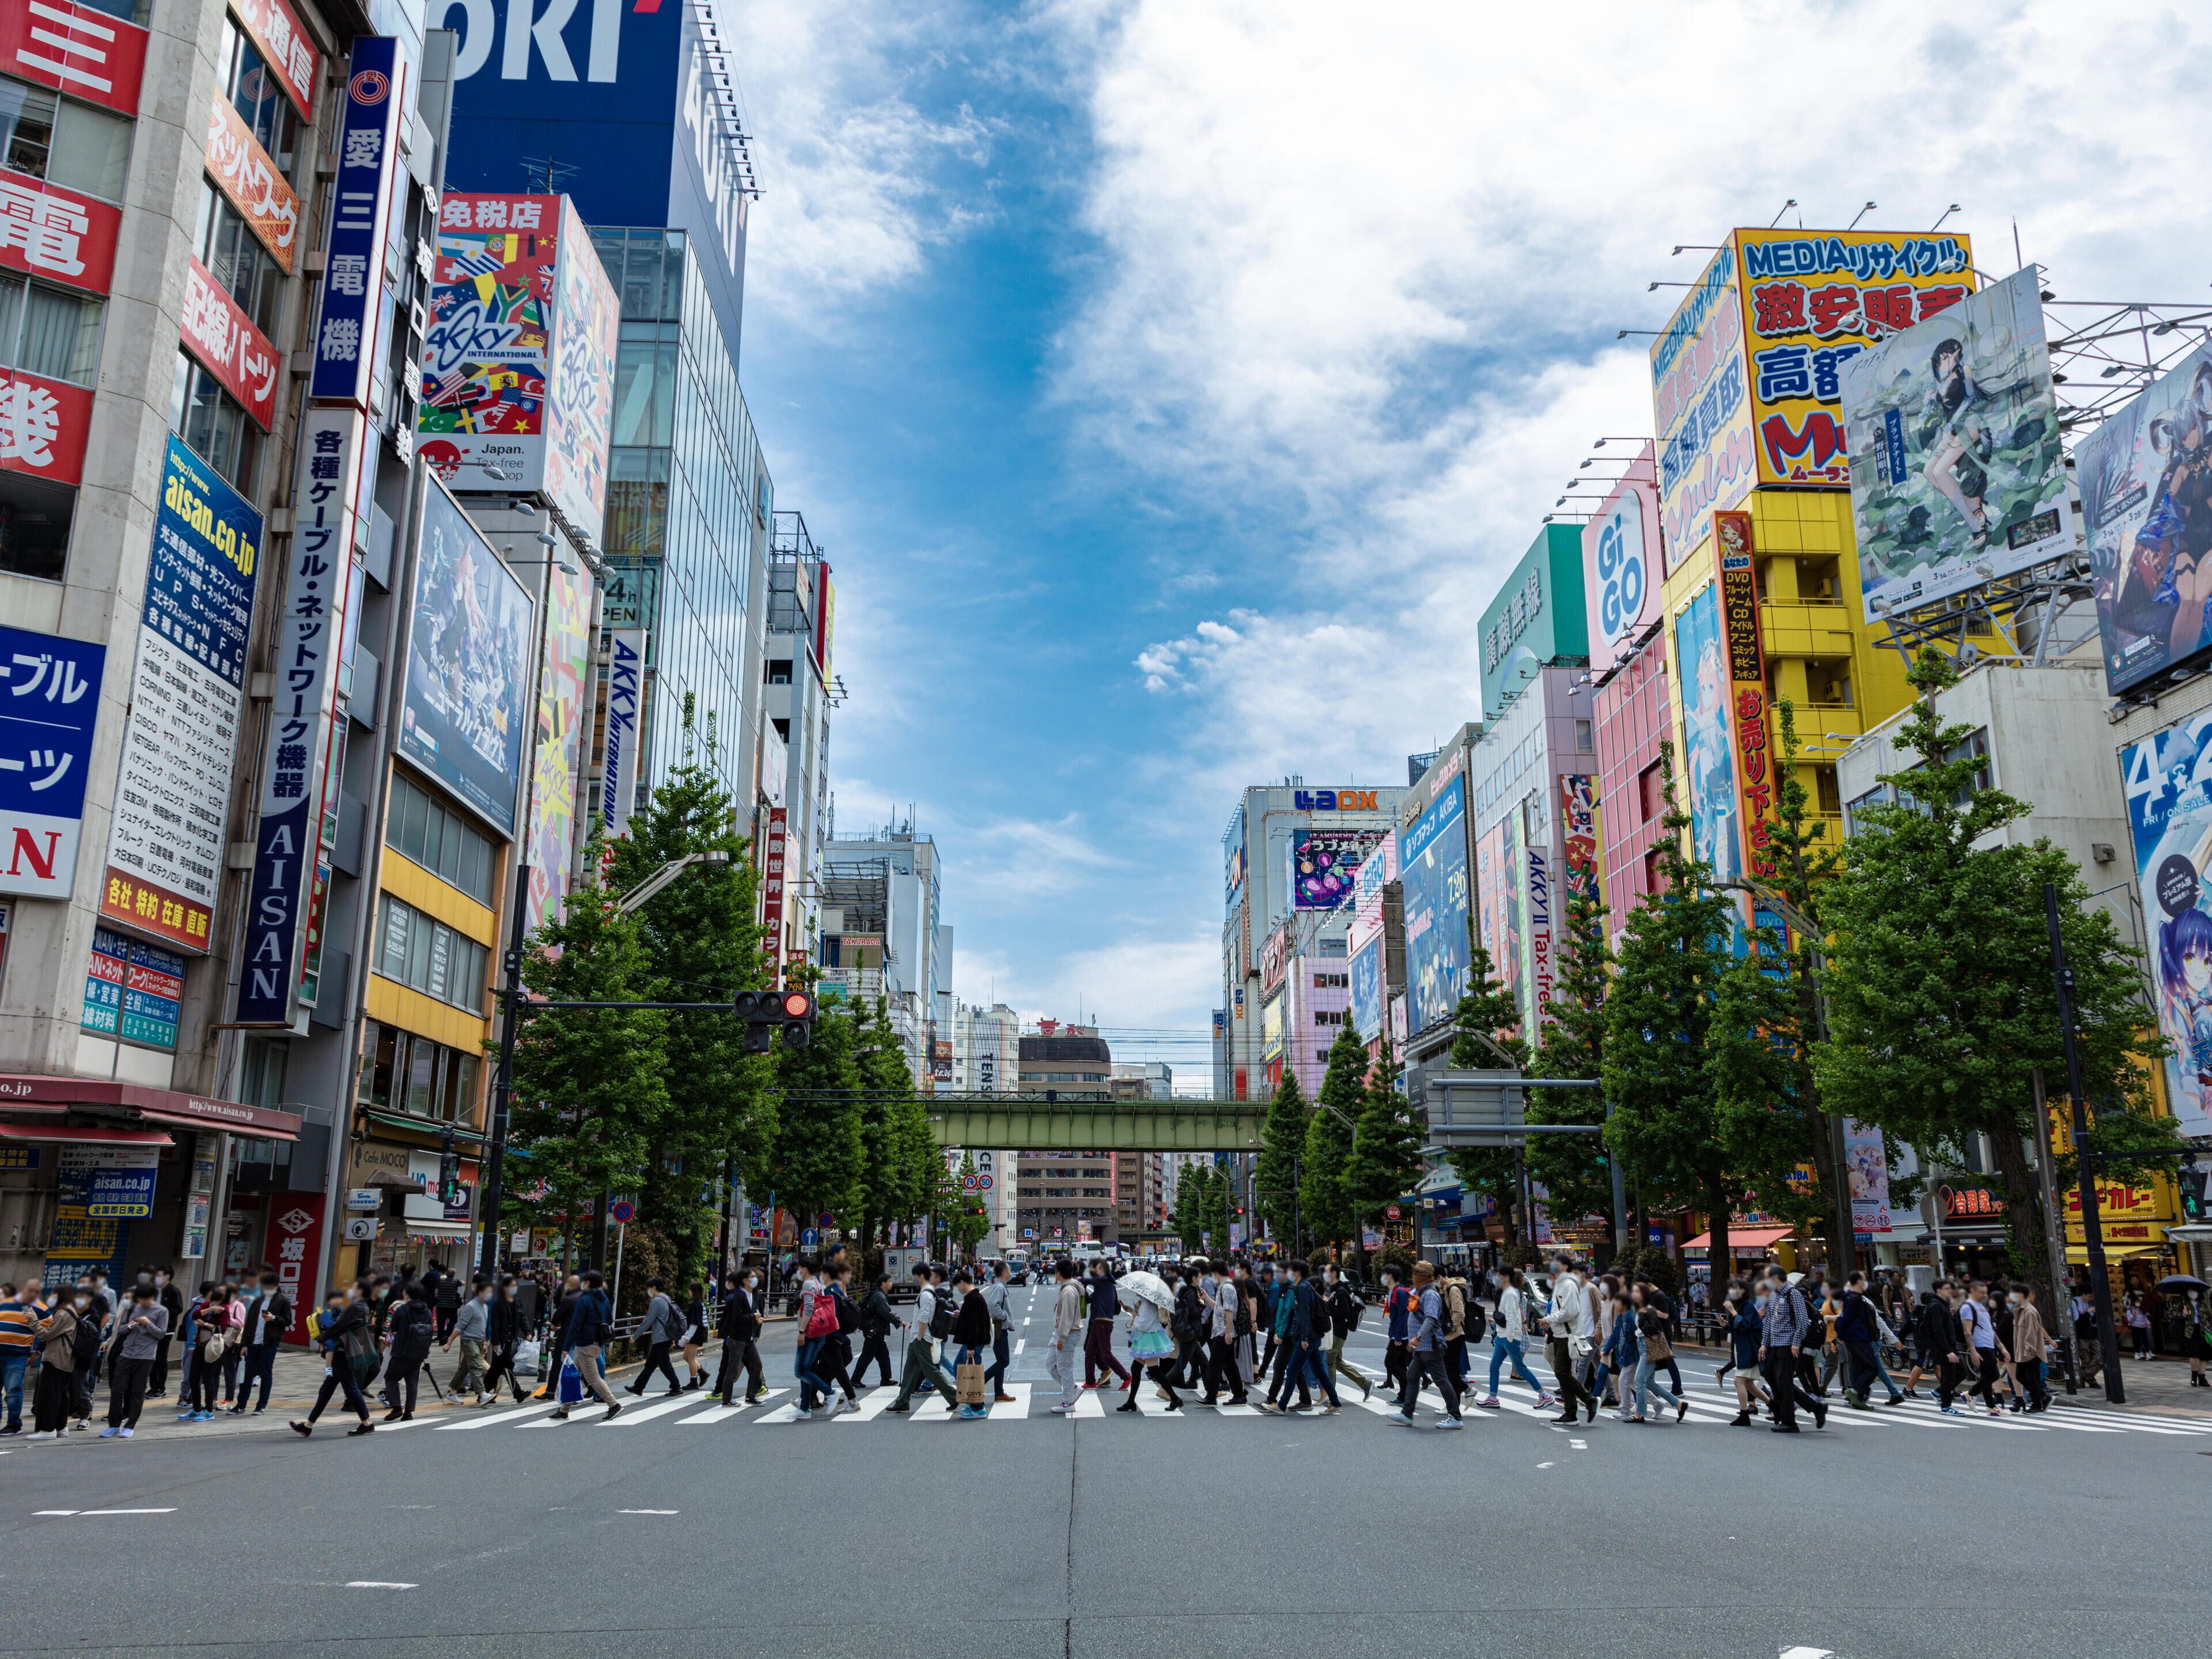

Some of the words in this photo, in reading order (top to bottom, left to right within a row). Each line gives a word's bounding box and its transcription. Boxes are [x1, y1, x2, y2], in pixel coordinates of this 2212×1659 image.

[683, 40, 741, 278] AOKI
[209, 101, 296, 248] ネットワーク
[441, 201, 542, 229] 免税店
[321, 128, 381, 361] 愛三電機
[182, 287, 276, 402] 配線パーツ
[467, 350, 537, 359] INTERNATIONAL
[1661, 351, 1744, 498] 高額買取
[482, 444, 525, 456] Japan.
[171, 450, 210, 496] http://www.
[504, 471, 523, 482] hop
[165, 475, 255, 577] aisan.co.jp
[1722, 557, 1749, 570] あなたの
[601, 577, 638, 603] 4h
[1725, 585, 1751, 595] ブルーレイ
[1726, 573, 1749, 583] DVD
[1602, 556, 1642, 635] GO
[1727, 597, 1752, 607] ゲーム
[273, 430, 343, 798] 各種ケーブル・ネットワーク機器
[1729, 620, 1754, 631] アイドル
[1733, 609, 1749, 619] CD
[1730, 633, 1756, 643] アニメ
[1732, 645, 1756, 656] コミック
[1734, 657, 1756, 668] ホビー
[1734, 670, 1759, 680] フィギュア
[611, 639, 638, 732] AKKY
[1431, 752, 1458, 797] ビックカメラ
[1405, 801, 1421, 826] Sofmap
[1411, 812, 1435, 851] ソフマップ
[1440, 791, 1457, 822] AKIBA
[2143, 815, 2158, 827] FRI
[2167, 807, 2181, 818] ON
[2184, 794, 2210, 812] SALE
[0, 827, 62, 880] N
[1448, 866, 1466, 904] 7.26
[1529, 850, 1548, 912] AKKY
[109, 877, 132, 910] 各社
[136, 888, 158, 920] 特約
[162, 899, 184, 929] 在庫
[186, 910, 208, 938] 直販
[249, 824, 295, 999] AISAN
[1758, 918, 1783, 926] DVD
[842, 937, 881, 946] TAKARADA
[189, 1099, 253, 1121] http://www.aisan.co.jp
[364, 1150, 379, 1164] Cafe
[380, 1154, 406, 1168] MOCO
[94, 1177, 150, 1191] aisan.co.jp
[93, 1206, 144, 1214] 全国即日発送
[1955, 1188, 1991, 1215] 吉野家
[280, 1238, 306, 1331] 坂口電
